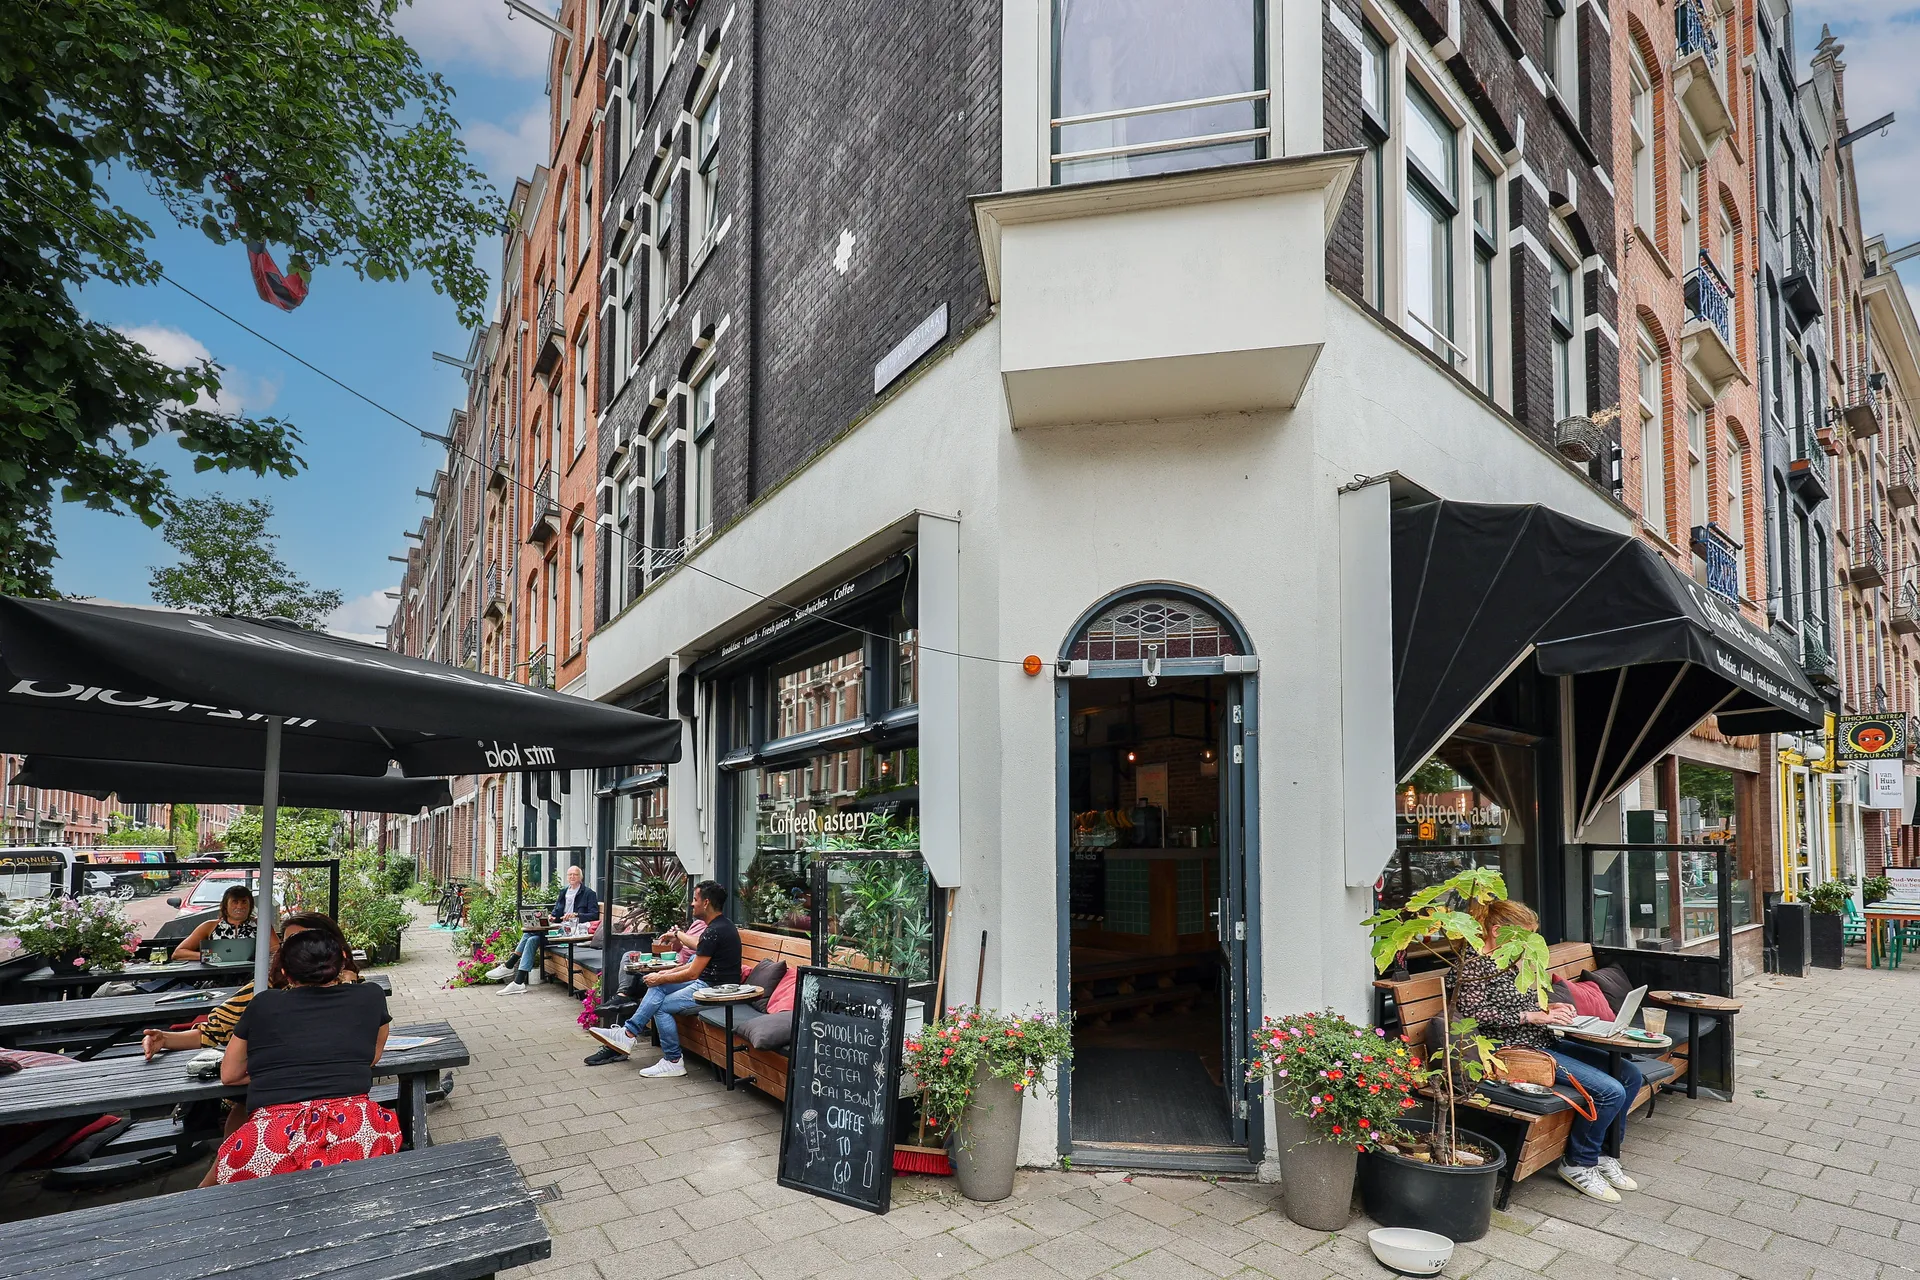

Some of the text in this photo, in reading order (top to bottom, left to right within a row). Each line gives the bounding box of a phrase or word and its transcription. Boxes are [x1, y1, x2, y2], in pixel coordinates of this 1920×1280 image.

[721, 640, 741, 657] Breakfast
[744, 632, 758, 646] Lunch
[761, 625, 775, 638] Fresh
[794, 597, 828, 621] Sandwiches
[833, 582, 855, 601] Coffee
[1740, 663, 1754, 684] Lunch
[1799, 697, 1810, 714] Coffee
[1840, 715, 1873, 723] ETHIOPIA
[1843, 752, 1899, 760] RESTAURANT
[836, 1136, 851, 1156] TO
[834, 1159, 851, 1184] GO
